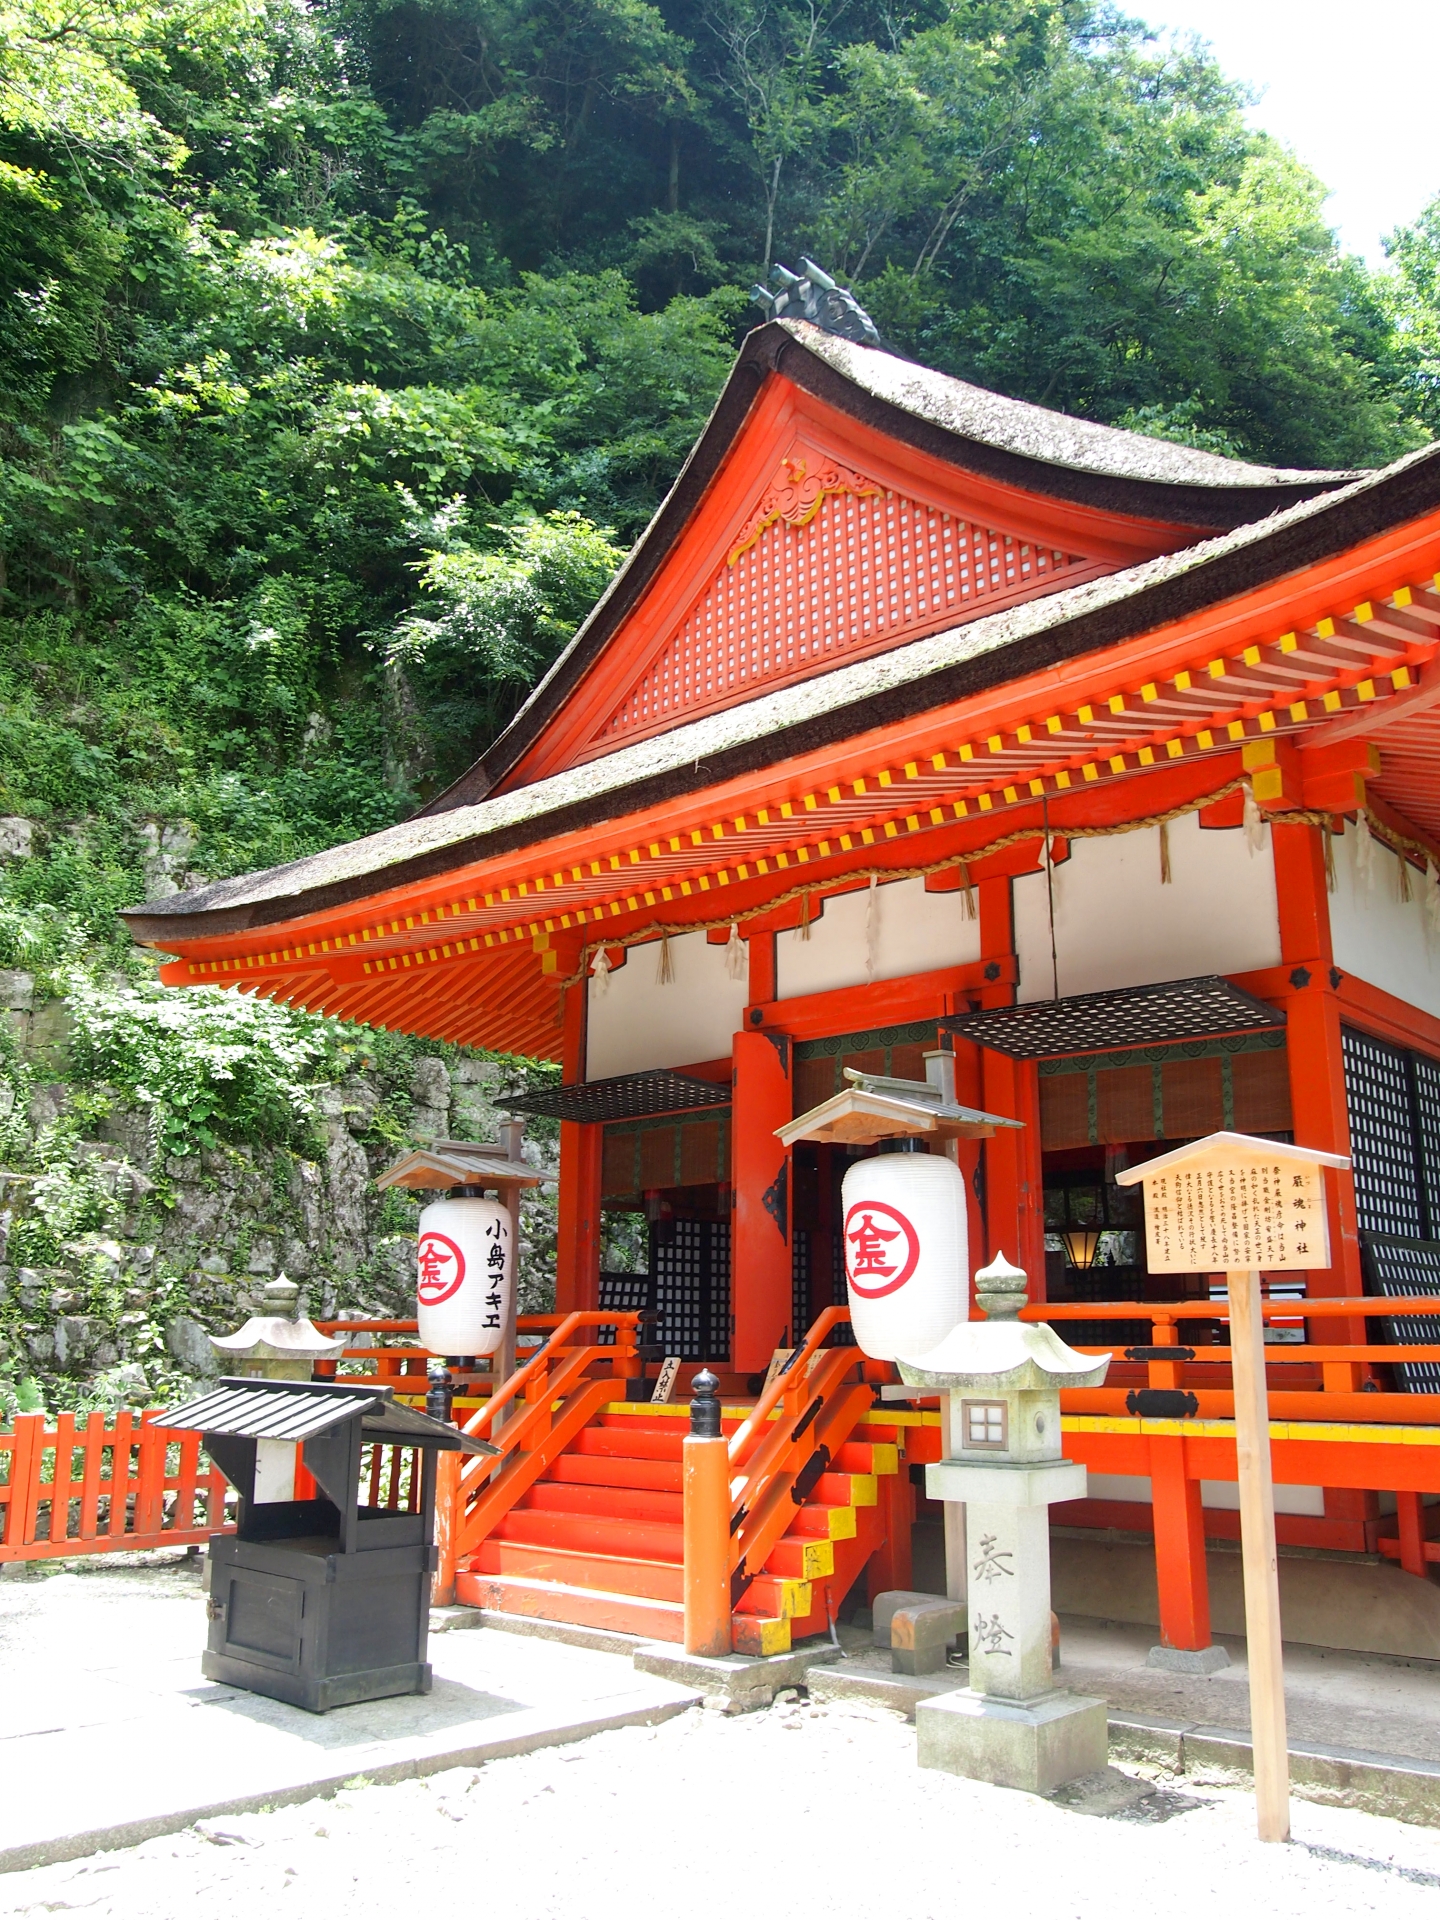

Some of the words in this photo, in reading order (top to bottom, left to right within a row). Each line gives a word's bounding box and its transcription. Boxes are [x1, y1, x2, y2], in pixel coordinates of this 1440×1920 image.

[418, 1242, 453, 1291] 金
[848, 1214, 901, 1278] 金
[652, 1359, 675, 1403] 立入禁止
[973, 1533, 1015, 1657] 奉燈
